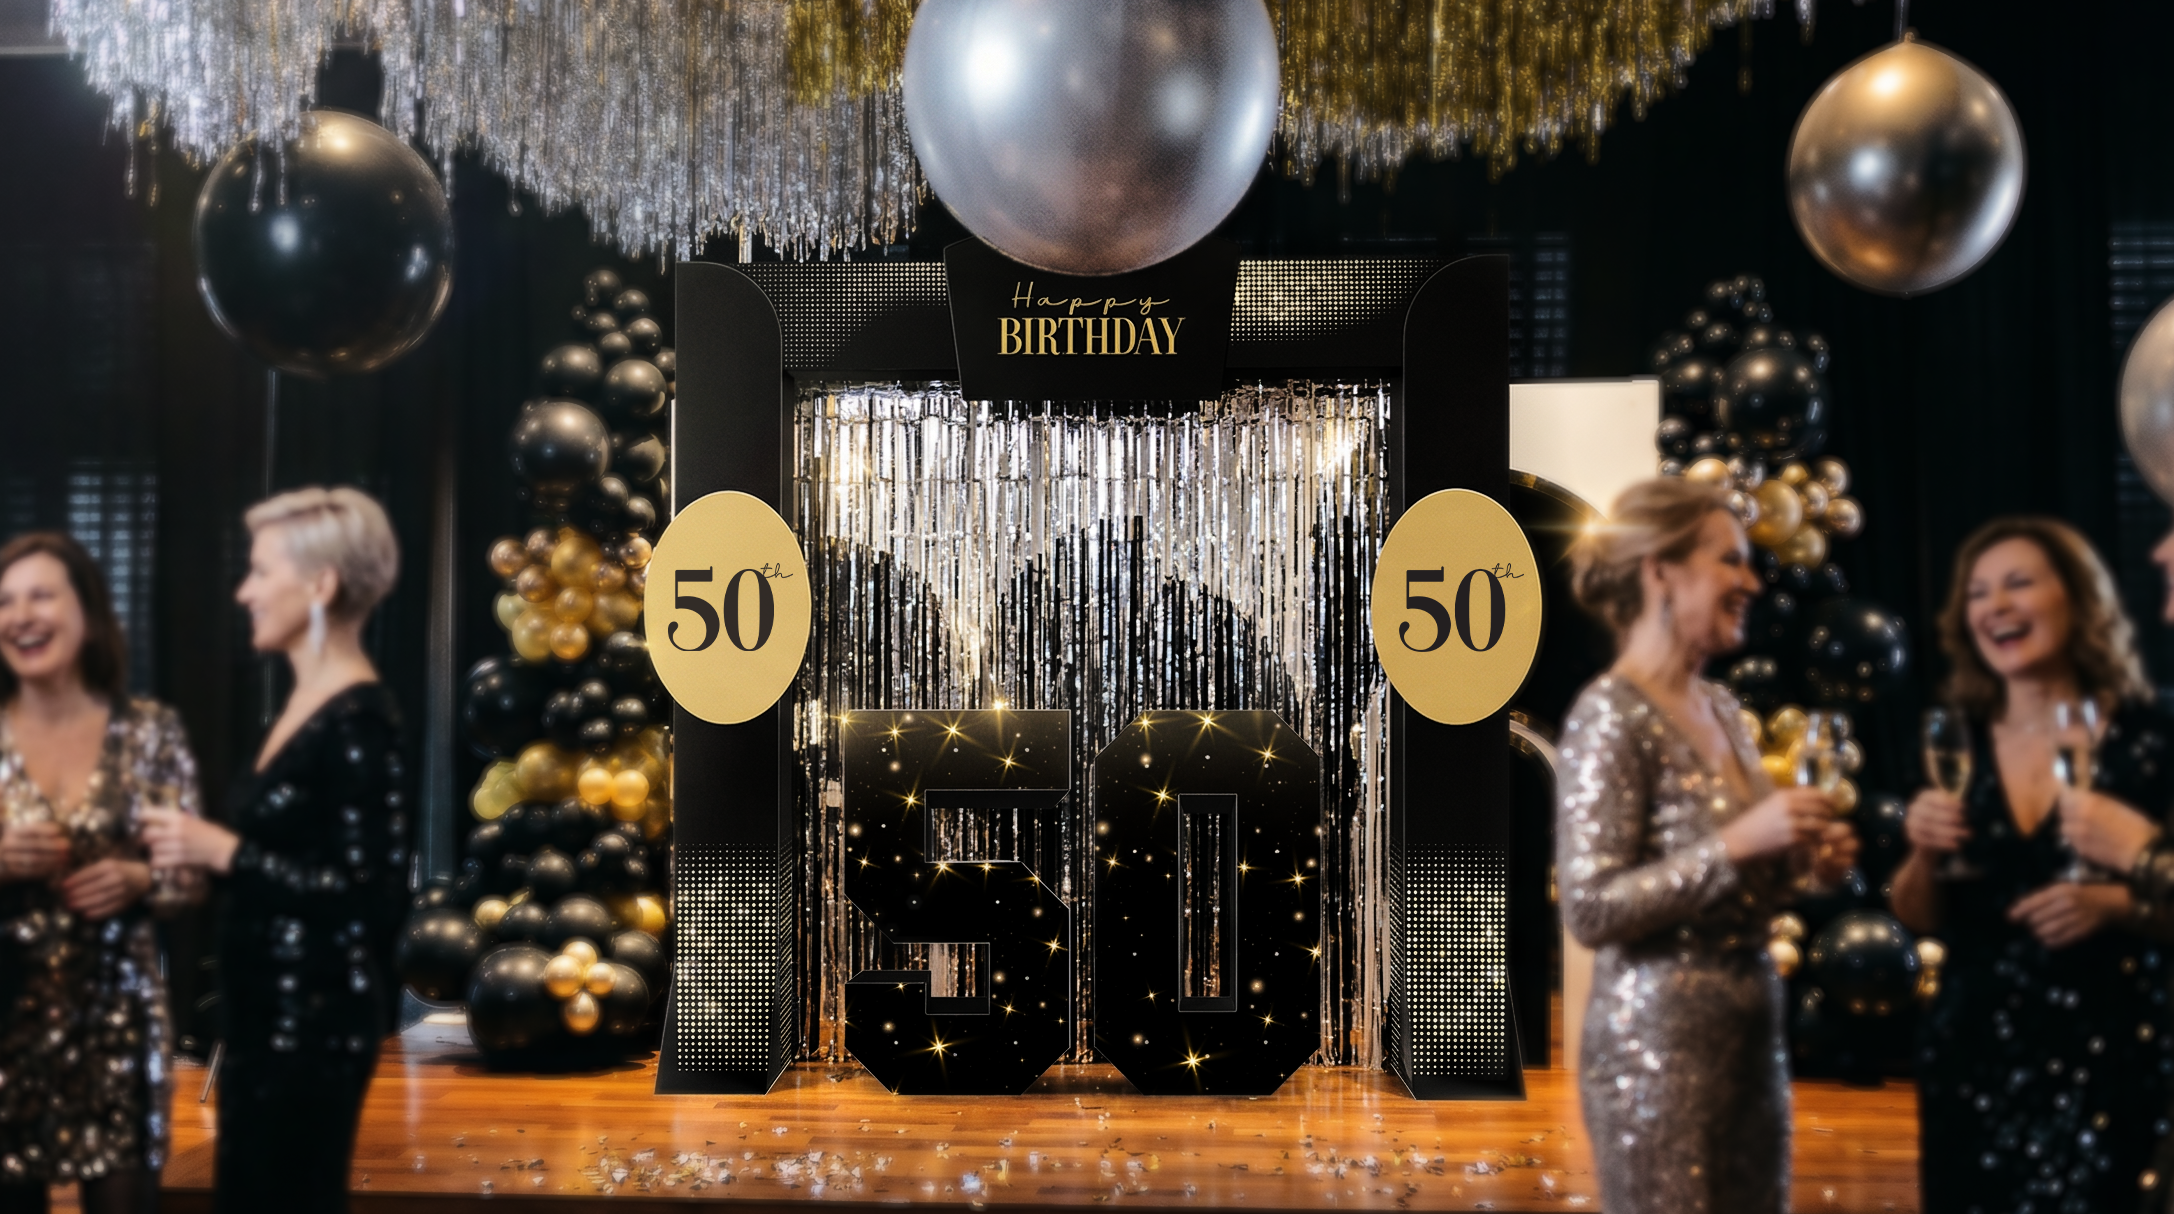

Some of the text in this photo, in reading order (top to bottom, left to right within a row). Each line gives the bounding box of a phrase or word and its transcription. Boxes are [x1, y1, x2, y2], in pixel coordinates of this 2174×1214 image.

[997, 317, 1186, 355] BIRTHDAY
[1012, 281, 1170, 315] Happy
[668, 563, 793, 651] 50th
[1399, 563, 1524, 652] 50th
[844, 709, 1321, 1095] 50
